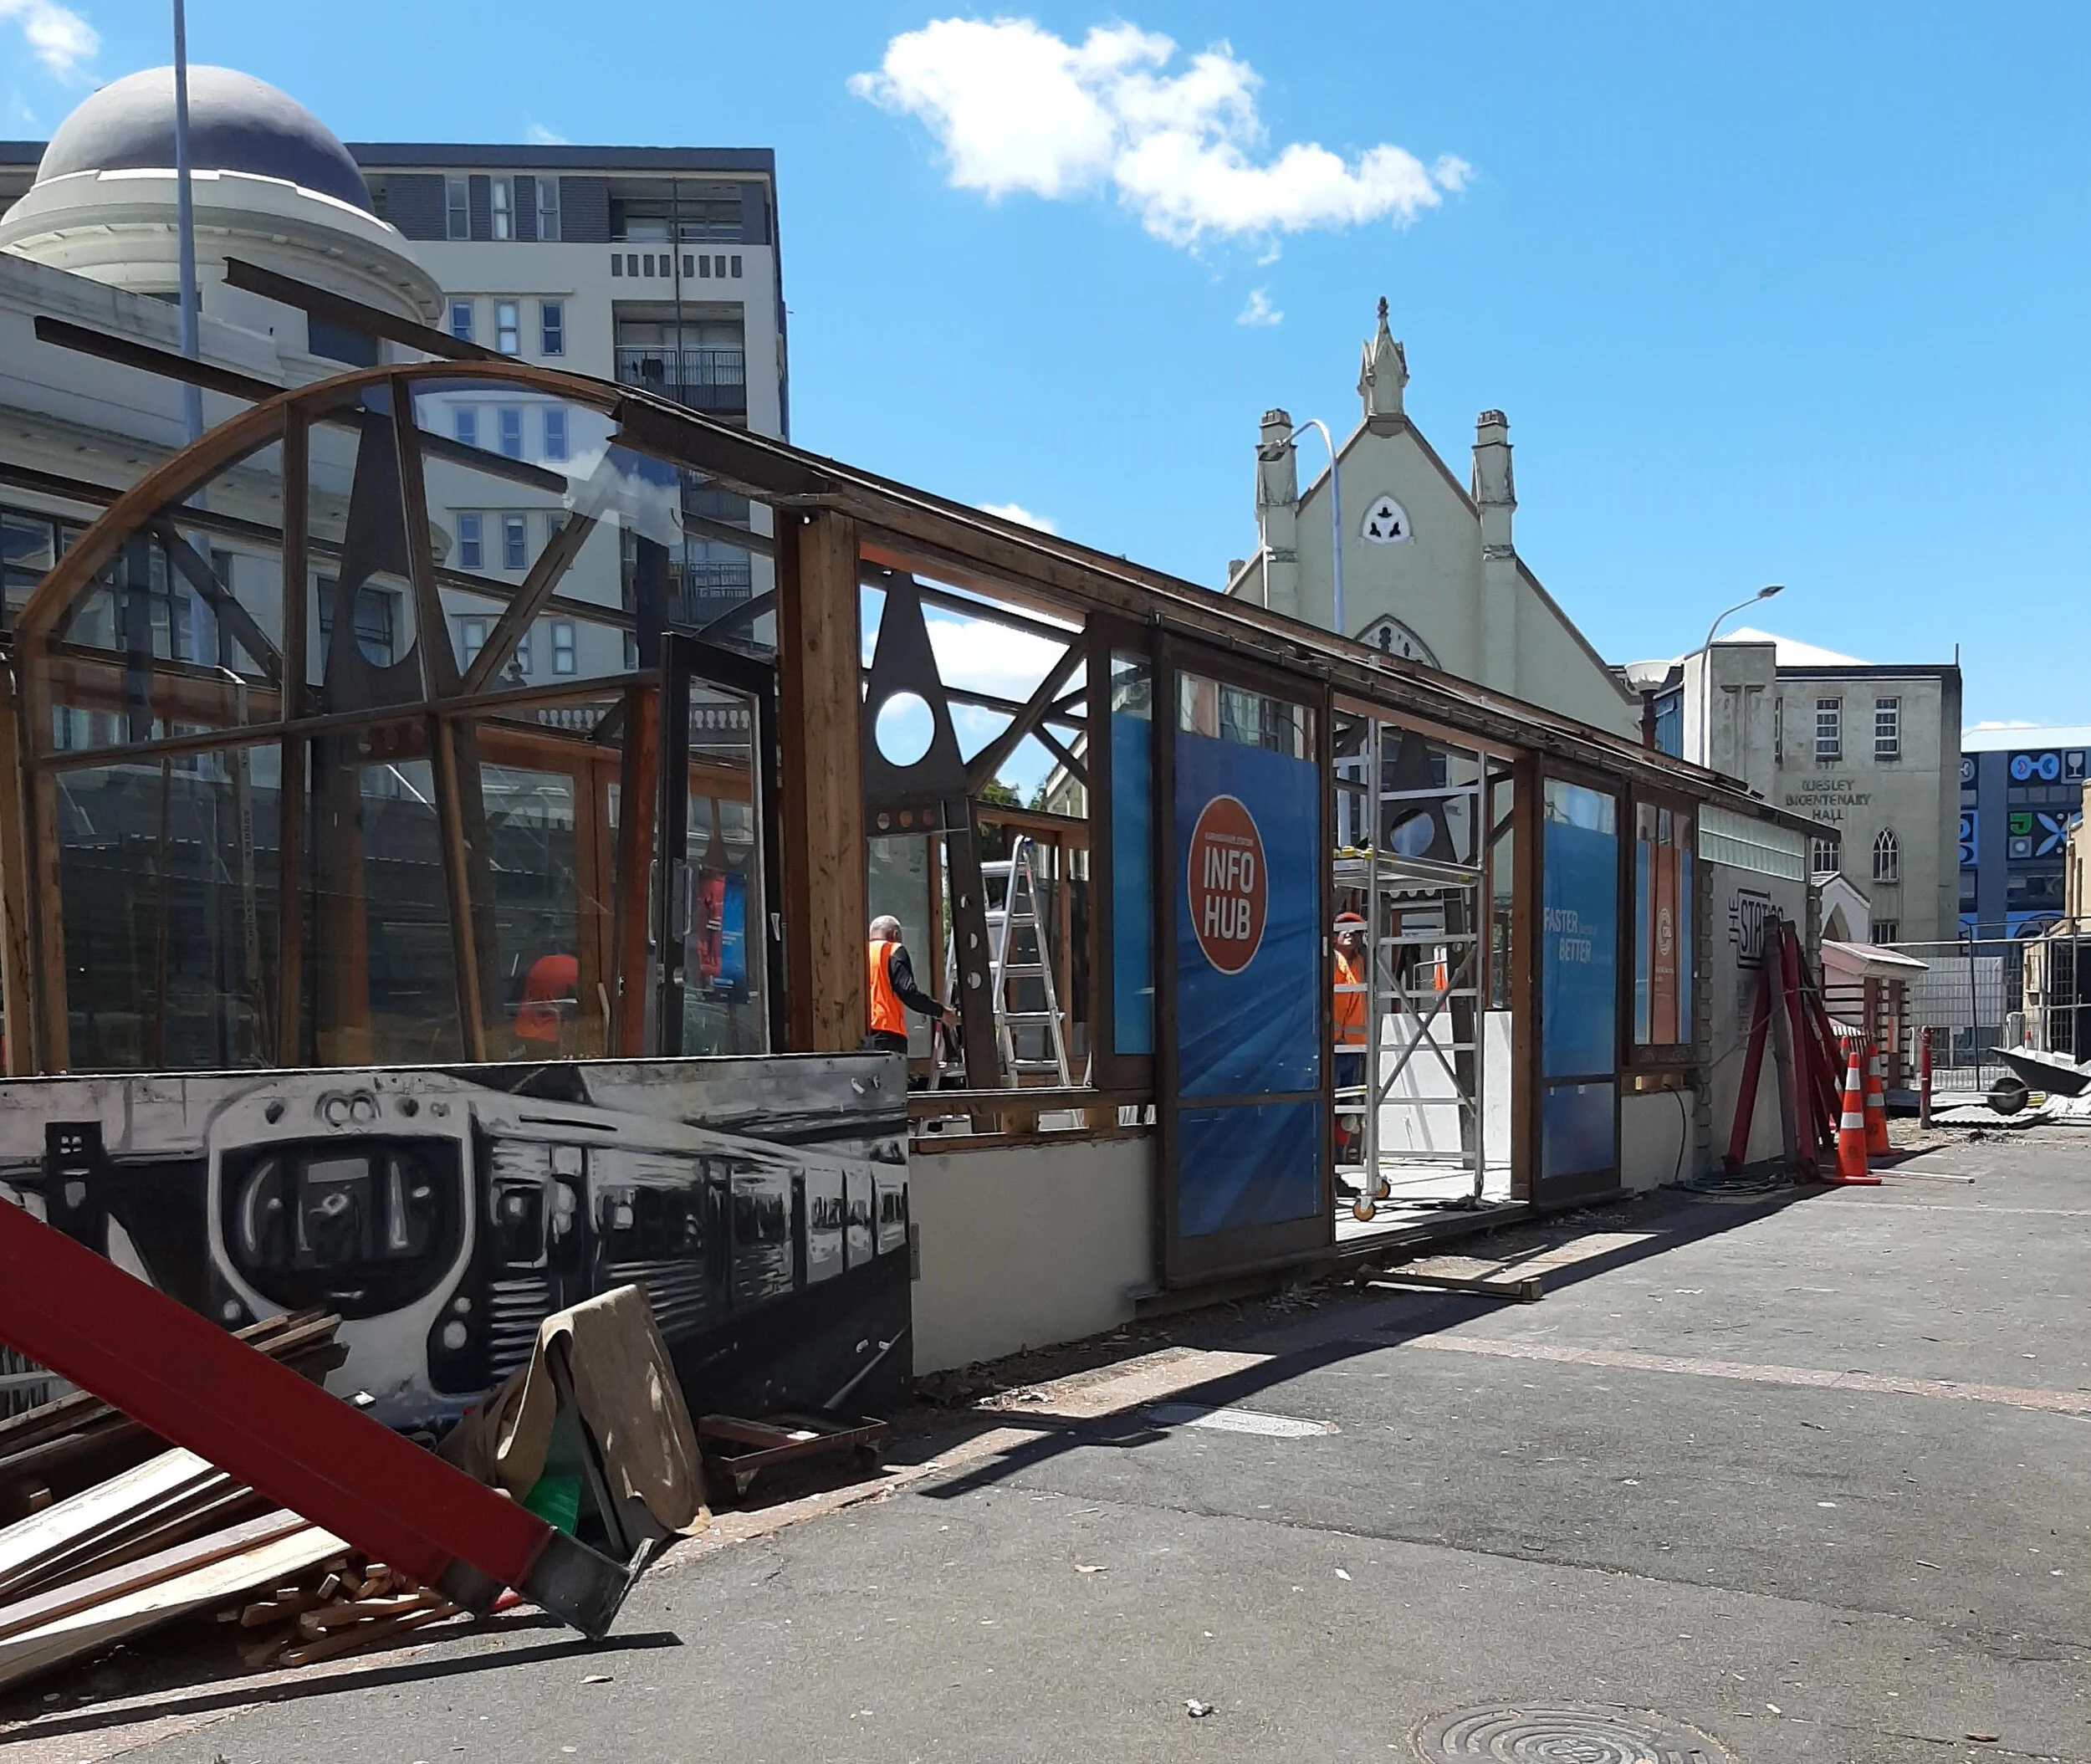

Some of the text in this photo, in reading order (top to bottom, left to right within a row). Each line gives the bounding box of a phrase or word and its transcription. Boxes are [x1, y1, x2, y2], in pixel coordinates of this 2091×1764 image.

[1802, 780, 1854, 791] WESLEY
[1812, 809, 1844, 821] HALL
[1204, 846, 1255, 894] INFO
[1204, 895, 1251, 940] HUB
[1543, 907, 1578, 934] FASTER
[1729, 897, 1740, 947] THE
[1558, 938, 1592, 964] BETTER
